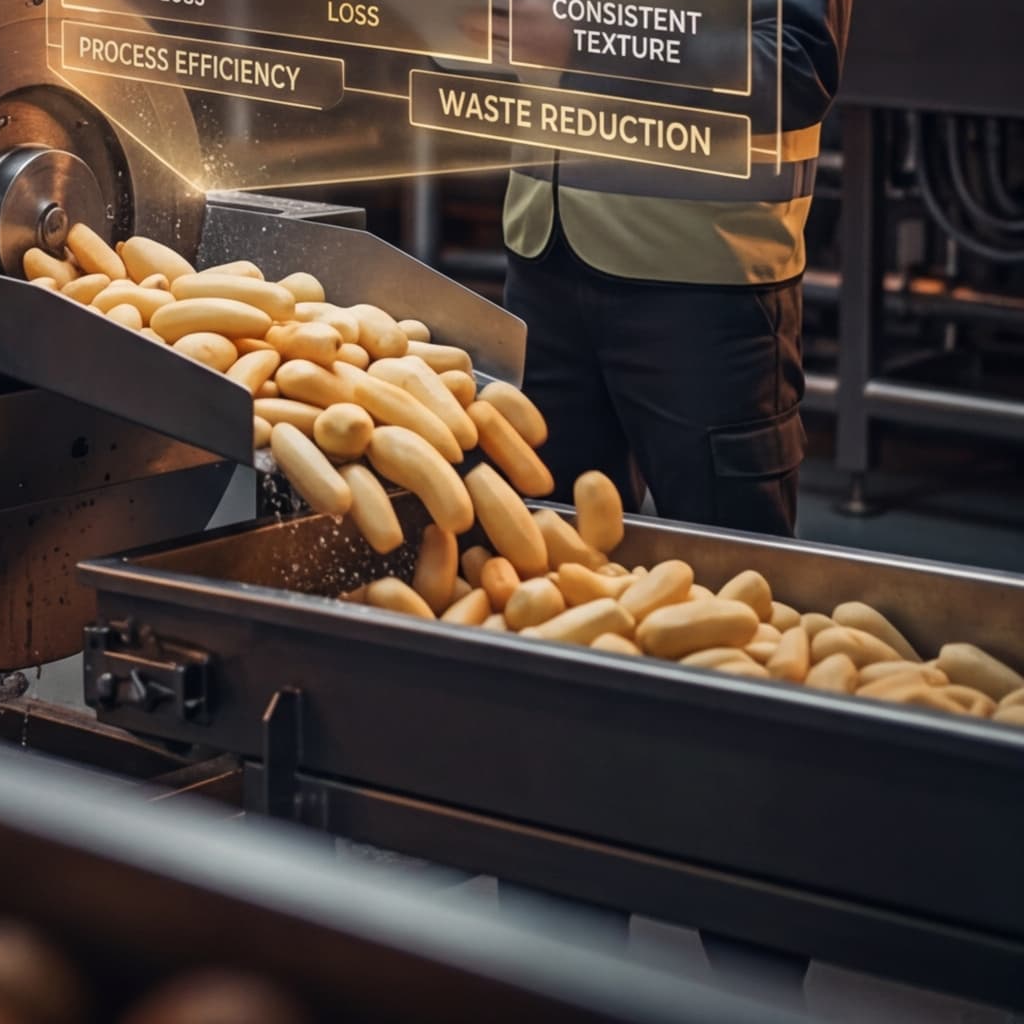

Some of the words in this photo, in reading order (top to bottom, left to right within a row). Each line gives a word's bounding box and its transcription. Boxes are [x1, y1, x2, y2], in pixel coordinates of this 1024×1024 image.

[327, 1, 380, 27] LOSS
[79, 37, 169, 71] PROCESS
[176, 50, 301, 91] EFFICIENCY
[573, 29, 681, 63] TEXTURE
[438, 88, 531, 128] WASTE
[541, 103, 711, 156] REDUCTION
